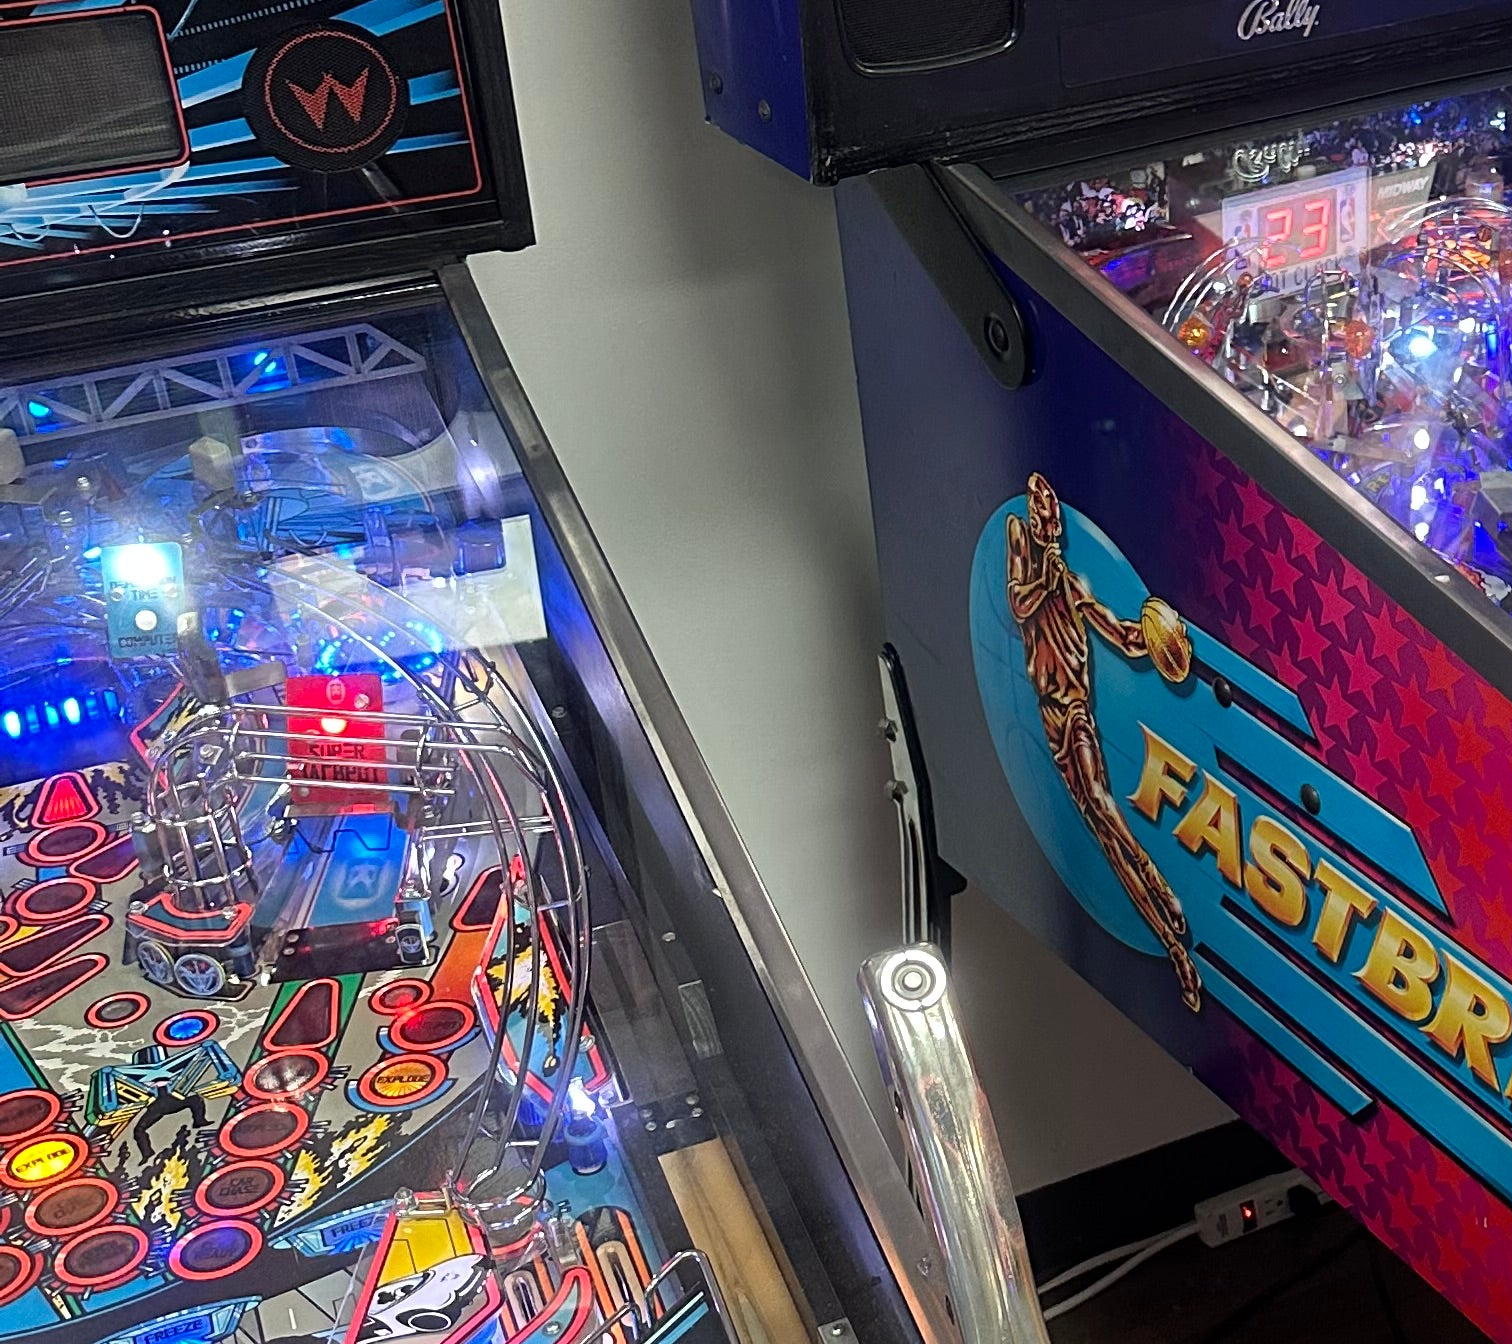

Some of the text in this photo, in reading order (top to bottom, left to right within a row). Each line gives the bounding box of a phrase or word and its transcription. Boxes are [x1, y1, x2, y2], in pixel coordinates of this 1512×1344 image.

[1377, 175, 1430, 200] MIDWAY
[1261, 198, 1331, 268] 23
[118, 632, 178, 647] COMPUTE
[376, 1072, 431, 1084] EXPLODE
